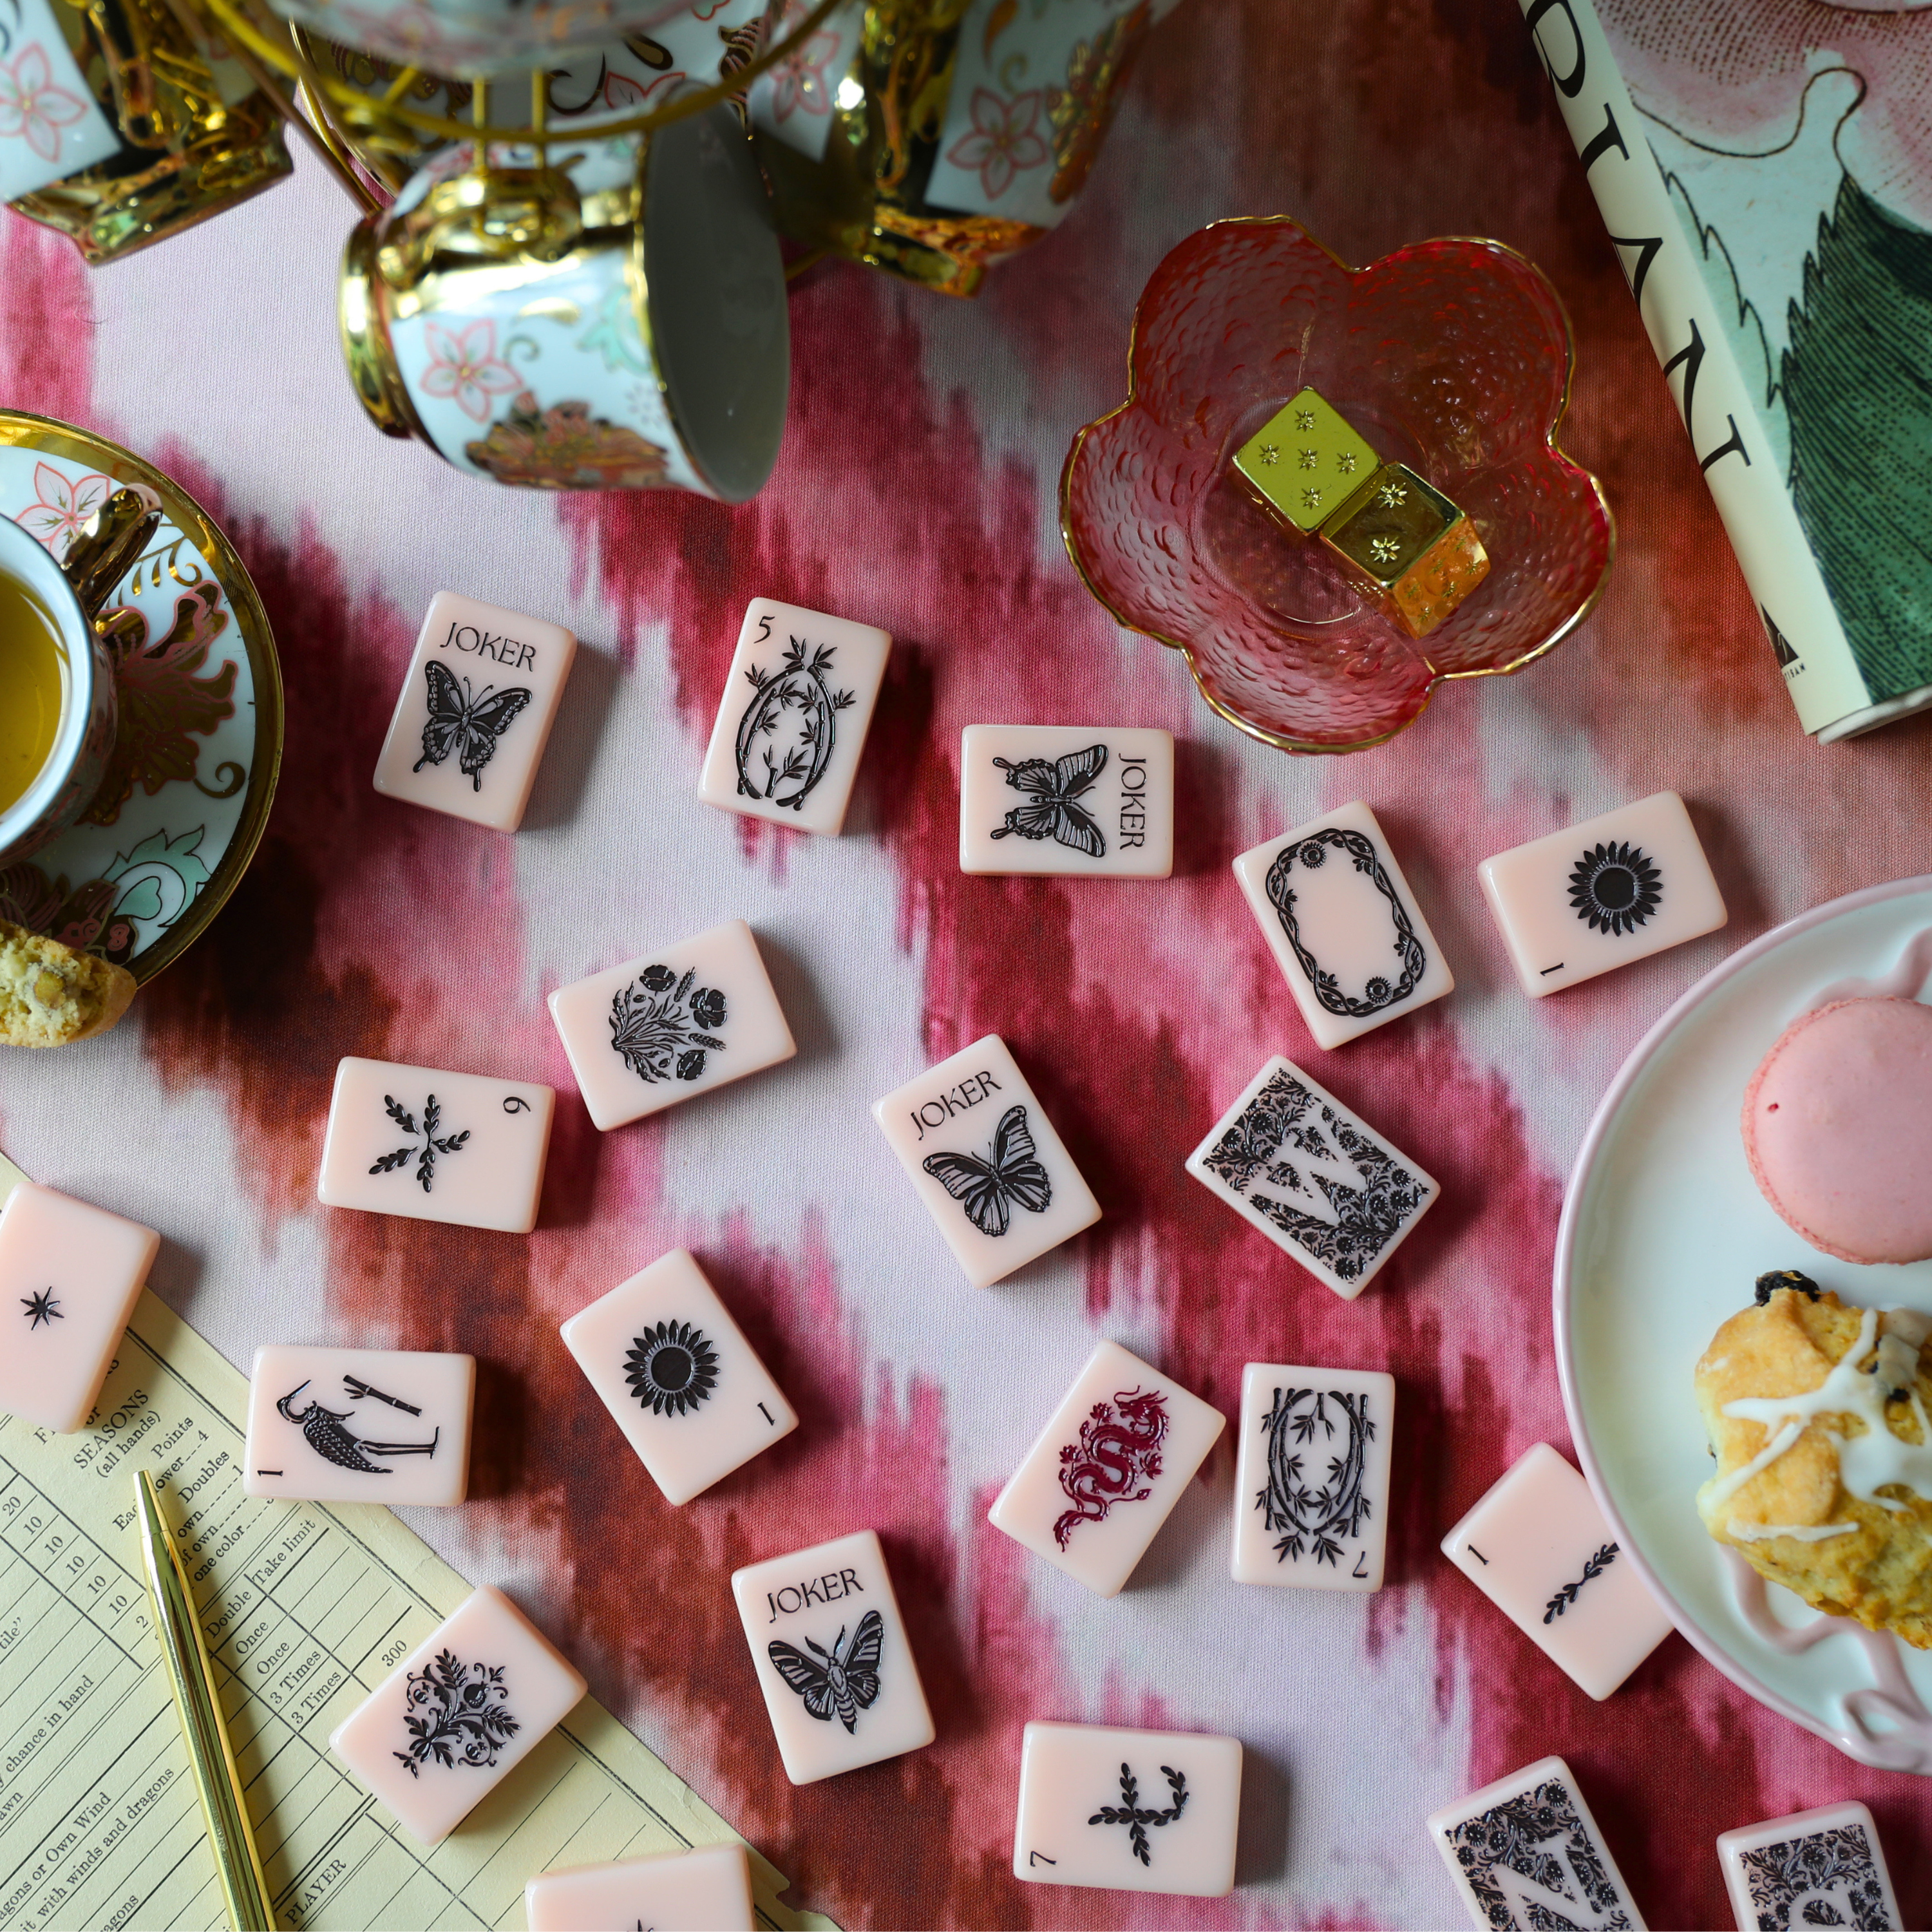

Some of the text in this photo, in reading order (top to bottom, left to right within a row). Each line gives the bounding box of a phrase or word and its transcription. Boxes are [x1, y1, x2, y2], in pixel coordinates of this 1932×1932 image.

[439, 622, 536, 672] JOKER
[754, 616, 775, 643] 5
[1119, 753, 1146, 849] JOKER
[1540, 963, 1564, 976] 1
[910, 1071, 1002, 1141] JOKER
[74, 1389, 148, 1469] SEASONS
[97, 1411, 160, 1477] (all hands)
[151, 1417, 193, 1459] Points
[112, 1430, 209, 1531] Eac ower 4
[177, 1452, 229, 1503] Doubles
[178, 1465, 243, 1538] own 1
[3, 1497, 20, 1516] 20
[24, 1517, 41, 1535] 10
[44, 1537, 62, 1555] 10
[192, 1526, 218, 1552] own
[194, 1526, 244, 1581] one color
[252, 1520, 315, 1584] Take limit
[66, 1556, 84, 1575] 10
[88, 1576, 106, 1594] 10
[109, 1596, 127, 1614] 10
[202, 1592, 251, 1639] Double
[768, 1569, 864, 1624] JOKER
[137, 1616, 148, 1628] 2
[236, 1622, 268, 1654] Once
[257, 1643, 289, 1674] Once
[270, 1651, 321, 1703] 3 Times
[382, 1640, 406, 1666] 300
[292, 1672, 341, 1723] 3 Times
[6, 1674, 94, 1772] chance in hand
[33, 1864, 46, 1880] or
[46, 1833, 77, 1861] Own
[73, 1792, 111, 1828] Wind
[37, 1888, 68, 1916] with
[66, 1847, 102, 1884] winds
[103, 1818, 128, 1846] and
[126, 1769, 174, 1819] dragons
[1030, 1851, 1056, 1866] 7
[284, 1860, 346, 1925] PLAYER
